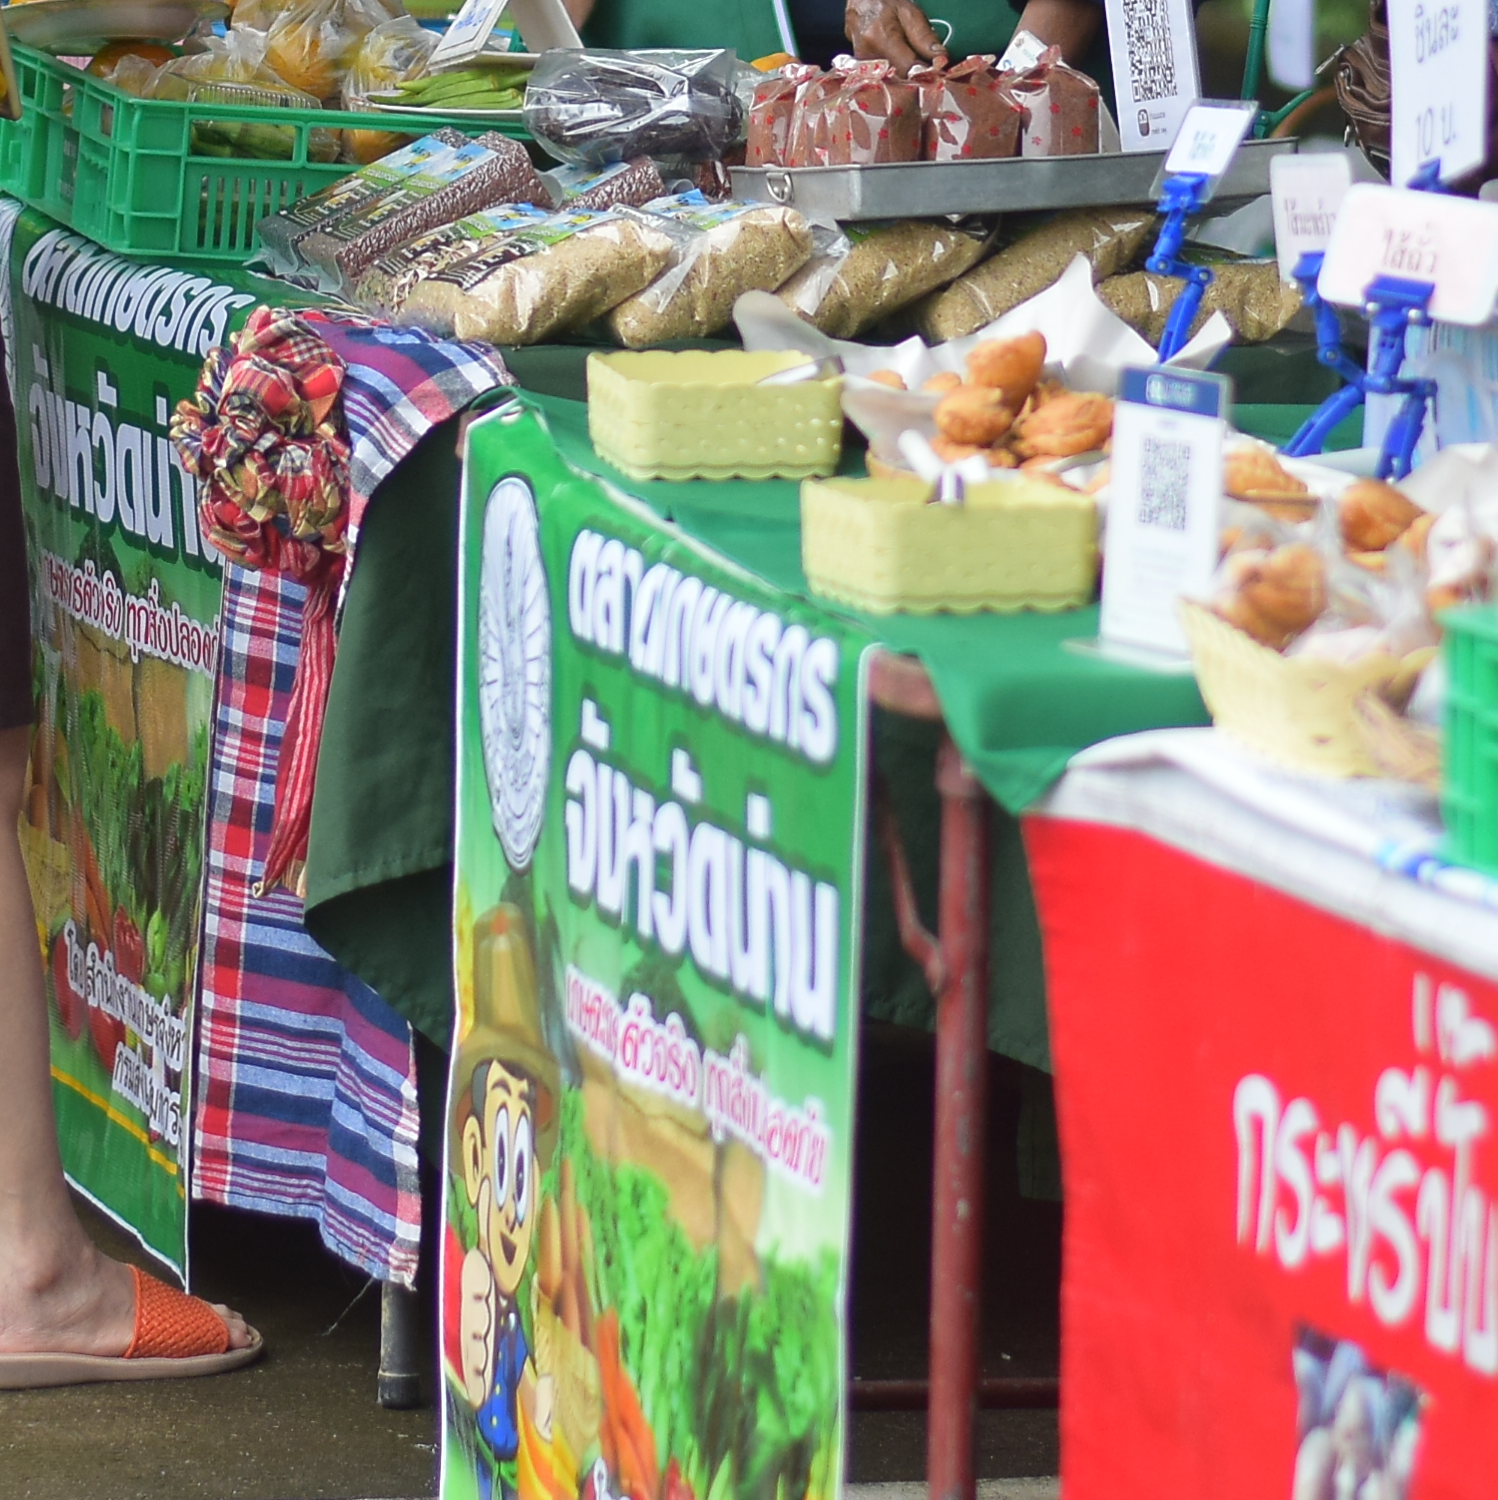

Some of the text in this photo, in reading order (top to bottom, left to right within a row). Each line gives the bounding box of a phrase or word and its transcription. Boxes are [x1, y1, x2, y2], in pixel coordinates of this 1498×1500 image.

[1416, 102, 1457, 161] 10 บ.
[22, 228, 256, 360] ตลาดเกษตรกร
[566, 529, 840, 766] ตลาดเกษตรกร
[564, 697, 840, 1038] จังหวัดน่าน
